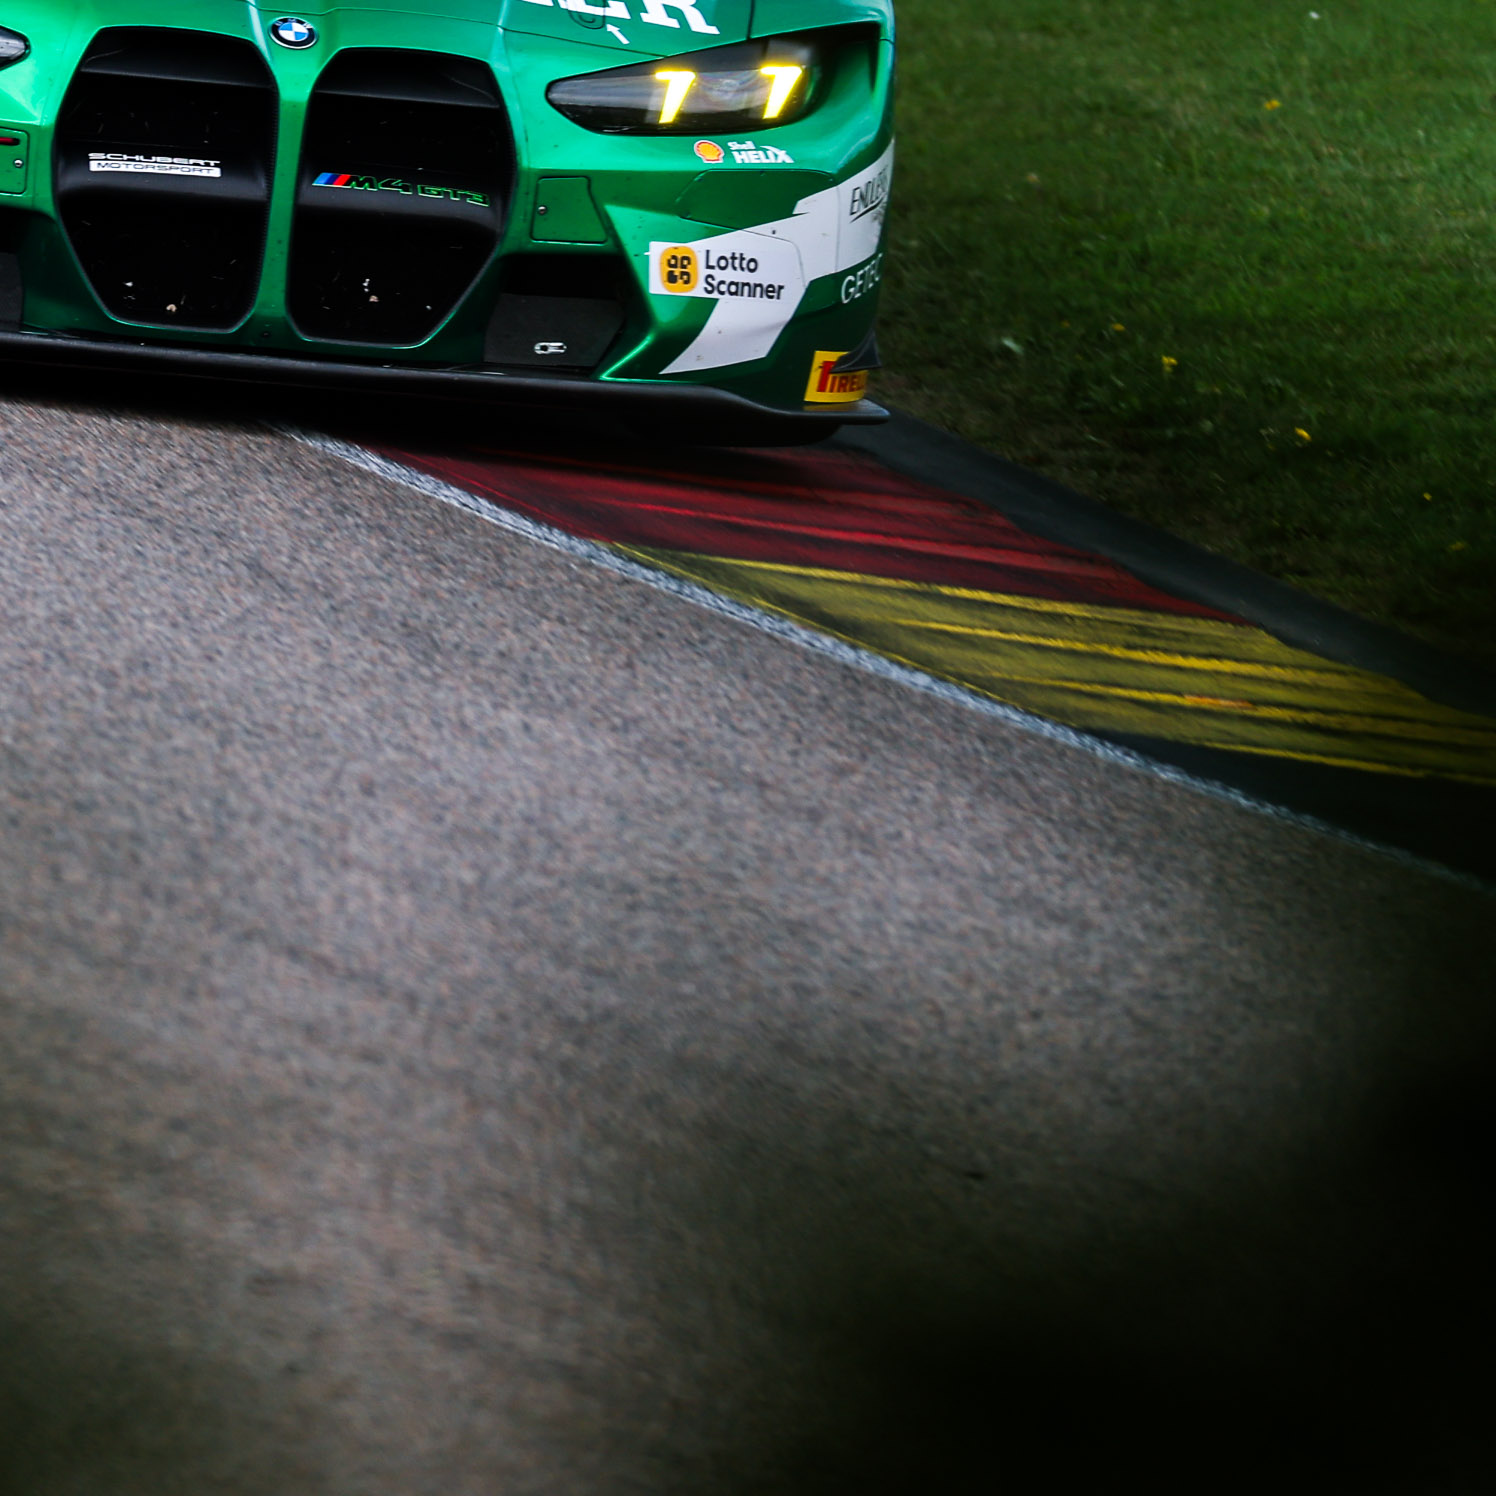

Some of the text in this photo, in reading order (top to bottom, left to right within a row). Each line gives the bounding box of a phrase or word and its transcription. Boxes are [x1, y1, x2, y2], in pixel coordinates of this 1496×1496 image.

[88, 152, 221, 167] SCHUBERT
[731, 145, 794, 164] HELIX
[96, 162, 215, 174] MOTORSPORT
[343, 174, 491, 207] M4 GT3
[704, 249, 759, 274] Lotto
[703, 273, 785, 302] Scanner
